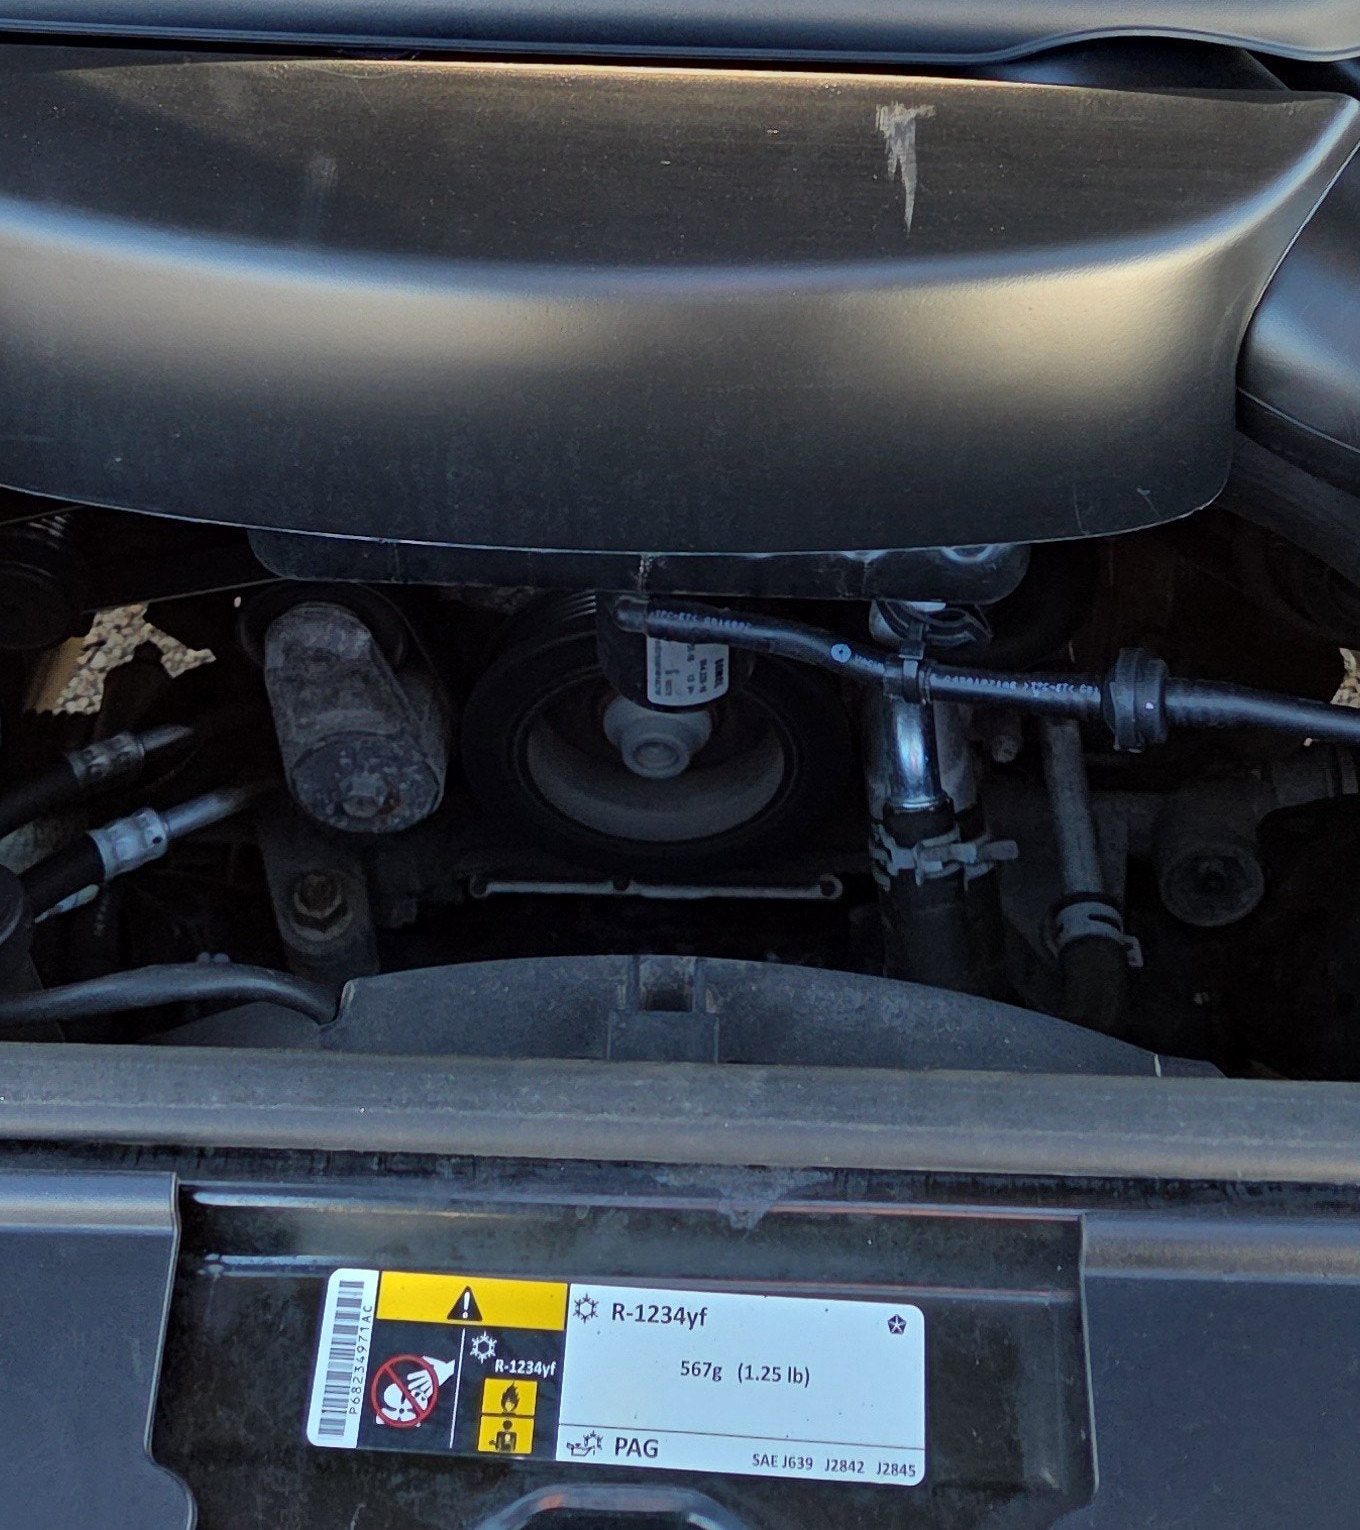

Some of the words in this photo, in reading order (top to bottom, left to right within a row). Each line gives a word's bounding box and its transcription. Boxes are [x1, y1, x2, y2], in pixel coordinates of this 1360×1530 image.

[612, 1302, 708, 1329] R-1234yf
[349, 1305, 373, 1415] P68234971AC
[494, 1358, 557, 1377] R-1234yf
[680, 1361, 723, 1382] 567g
[738, 1362, 782, 1384] (1.25
[786, 1365, 811, 1388] lb)
[614, 1435, 659, 1459] PAG
[752, 1452, 780, 1468] SAE
[782, 1453, 813, 1471] J639
[824, 1458, 865, 1475] J2842
[876, 1462, 917, 1478] J2845
